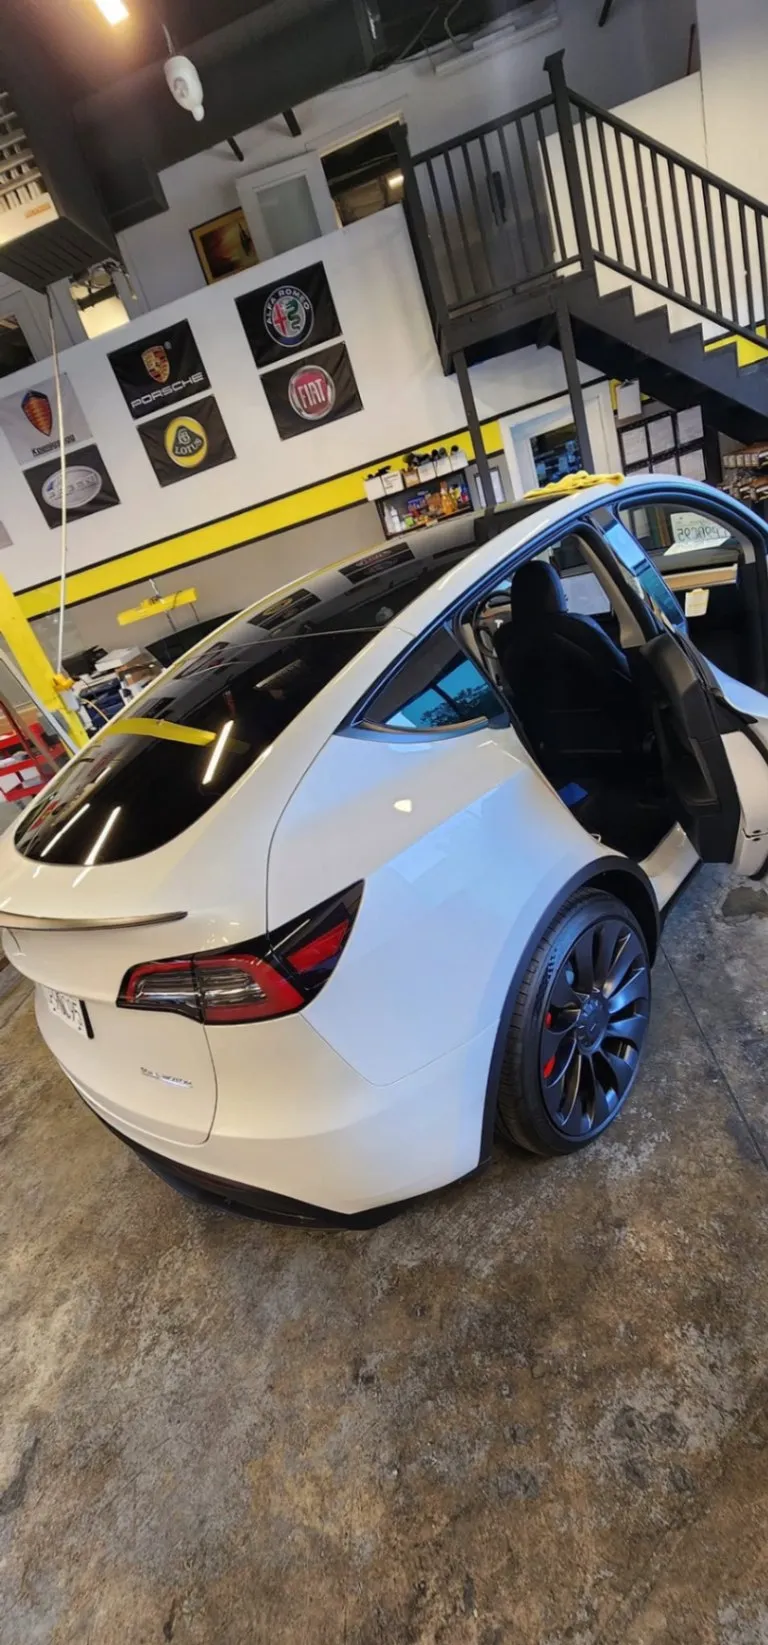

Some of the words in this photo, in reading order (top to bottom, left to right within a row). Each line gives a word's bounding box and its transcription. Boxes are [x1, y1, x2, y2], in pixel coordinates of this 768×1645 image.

[266, 297, 277, 325] ALFA
[278, 288, 310, 310] ROMEO
[130, 371, 205, 409] PORSCHE
[297, 378, 326, 409] FIAT
[174, 437, 202, 455] LOTUS
